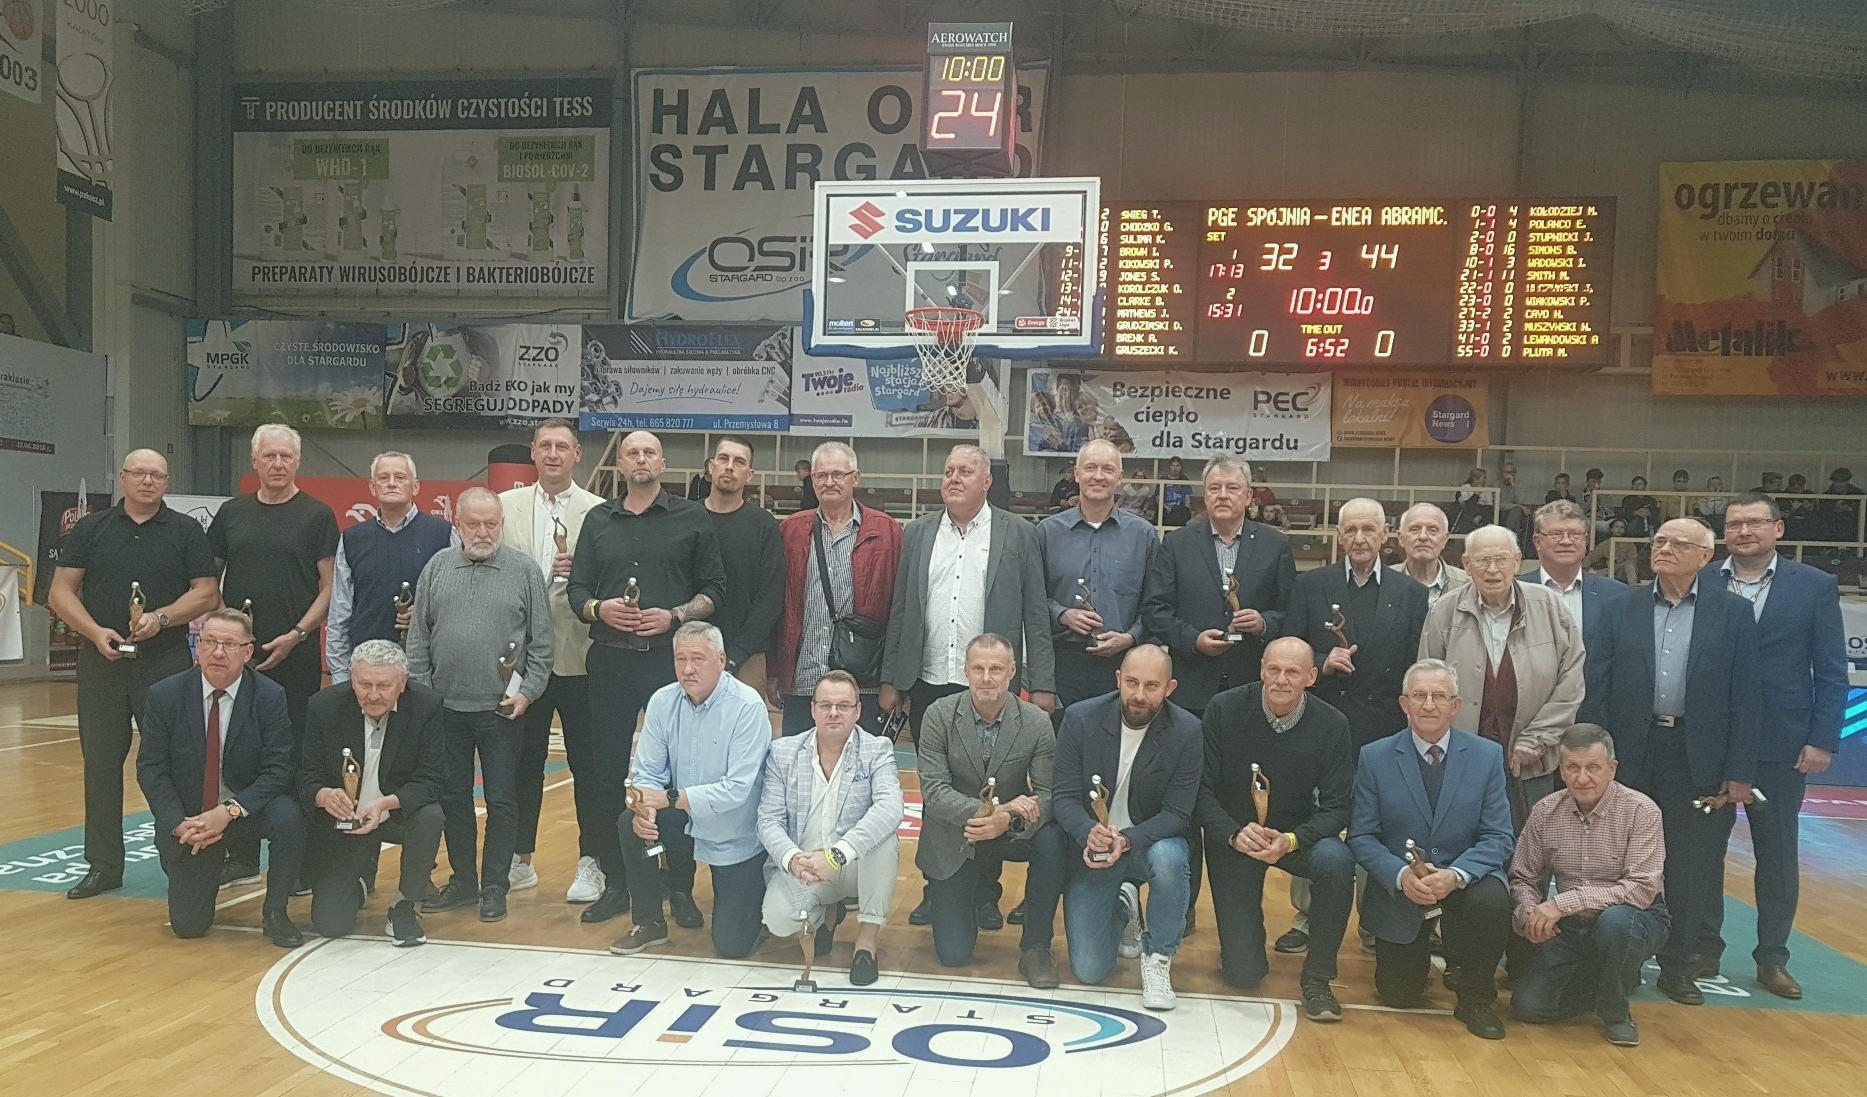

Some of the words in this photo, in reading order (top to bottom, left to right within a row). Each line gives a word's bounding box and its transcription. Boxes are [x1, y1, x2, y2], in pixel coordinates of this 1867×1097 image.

[931, 33, 1008, 43] AEROWATCH
[942, 56, 1005, 81] 10:00
[266, 101, 363, 121] PRODUCENT
[369, 94, 451, 120] ŚRODKÓW
[457, 92, 547, 118] CZYSTOŚCI
[553, 96, 593, 117] TESS
[651, 87, 828, 135] HALA
[931, 90, 1001, 139] 24
[316, 158, 367, 176] WHO-1
[503, 163, 588, 178] BIOSOL-COV-2
[649, 143, 1032, 192] STARGA
[895, 206, 1051, 232] SUZUKI
[1207, 207, 1238, 226] PGE
[1247, 207, 1311, 226] SPÓJNIA
[1331, 206, 1372, 226] ENEA
[1381, 206, 1448, 226] ABRAMC.
[1718, 212, 1759, 227] dbamy
[1763, 215, 1770, 226] o
[1121, 222, 1159, 231] CHODZKO
[1529, 220, 1572, 229] POLANCO
[1206, 231, 1227, 241] SET
[1529, 232, 1579, 242] STUPNICKI
[1700, 231, 1709, 241] w
[1713, 230, 1752, 241] twoim
[1119, 247, 1147, 256] BROWN
[1232, 248, 1238, 260] 1
[1259, 242, 1299, 271] 32
[1360, 243, 1400, 270] 44
[1528, 245, 1563, 255] SIMONS
[1119, 259, 1159, 269] KIKOWSKI
[1319, 250, 1332, 271] 3
[251, 265, 334, 283] PREPARATY
[338, 261, 451, 284] WIRUSOBÓJCZE
[456, 266, 461, 284] I
[466, 261, 595, 284] BAKTERIOBÓJCZE
[709, 274, 772, 282] STARGARD
[1119, 272, 1147, 281] JONES
[1209, 263, 1244, 278] 17:13
[1527, 270, 1556, 280] SMITH
[1226, 287, 1236, 300] 2
[1118, 297, 1151, 306] CLARKE
[1207, 303, 1242, 318] 15:31
[1525, 309, 1550, 319] CAYO
[829, 319, 854, 327] molten
[1301, 324, 1323, 335] TIME
[1323, 324, 1343, 335] OUT
[1116, 333, 1144, 343] BRENK
[1249, 329, 1269, 357] 0
[1374, 329, 1395, 357] 0
[1523, 334, 1587, 345] LEWANDOWSKI
[1666, 319, 1800, 357] Metalik
[274, 341, 309, 352] CZYSTE
[312, 339, 381, 354] ŚRODOWISKO
[519, 345, 560, 361] ZZO
[1305, 338, 1349, 357] 6:52
[1522, 347, 1554, 357] PLUTA
[206, 352, 250, 364] MPGK
[287, 355, 306, 365] DLA
[308, 355, 367, 367] STARGARDU
[624, 365, 660, 374] siłowników
[670, 366, 704, 375] zakuwanie
[706, 366, 722, 376] węży
[732, 366, 760, 375] obróbka
[761, 366, 776, 375] CNC
[870, 364, 921, 378] Najbliższ
[531, 379, 551, 395] jak
[554, 384, 575, 397] my
[801, 367, 854, 394] Twoje
[844, 383, 864, 393] radio
[885, 375, 917, 388] stacja
[630, 382, 666, 397] Dajemy
[669, 383, 685, 396] siłę
[687, 382, 741, 397] hydraulice!
[875, 384, 919, 399] Stargard
[1112, 380, 1231, 405] Bezpieczne
[424, 396, 505, 412] SEGREGUJ
[506, 399, 575, 414] ODPADY
[1253, 390, 1310, 412] PEC
[591, 416, 616, 427] Serwis
[617, 417, 634, 429] 24h,
[636, 418, 647, 428] tel.
[649, 418, 664, 428] 665
[666, 418, 680, 428] 820
[683, 418, 694, 429] 777
[713, 419, 722, 429] ul.
[724, 419, 772, 430] Przemysłowa
[773, 419, 779, 429] 8
[1134, 405, 1198, 428] ciepło
[1432, 410, 1470, 421] Stargard
[1432, 420, 1456, 429] News
[1151, 430, 1183, 449] dla
[1191, 430, 1299, 454] Stargardu
[542, 977, 1055, 1025] STARGARD
